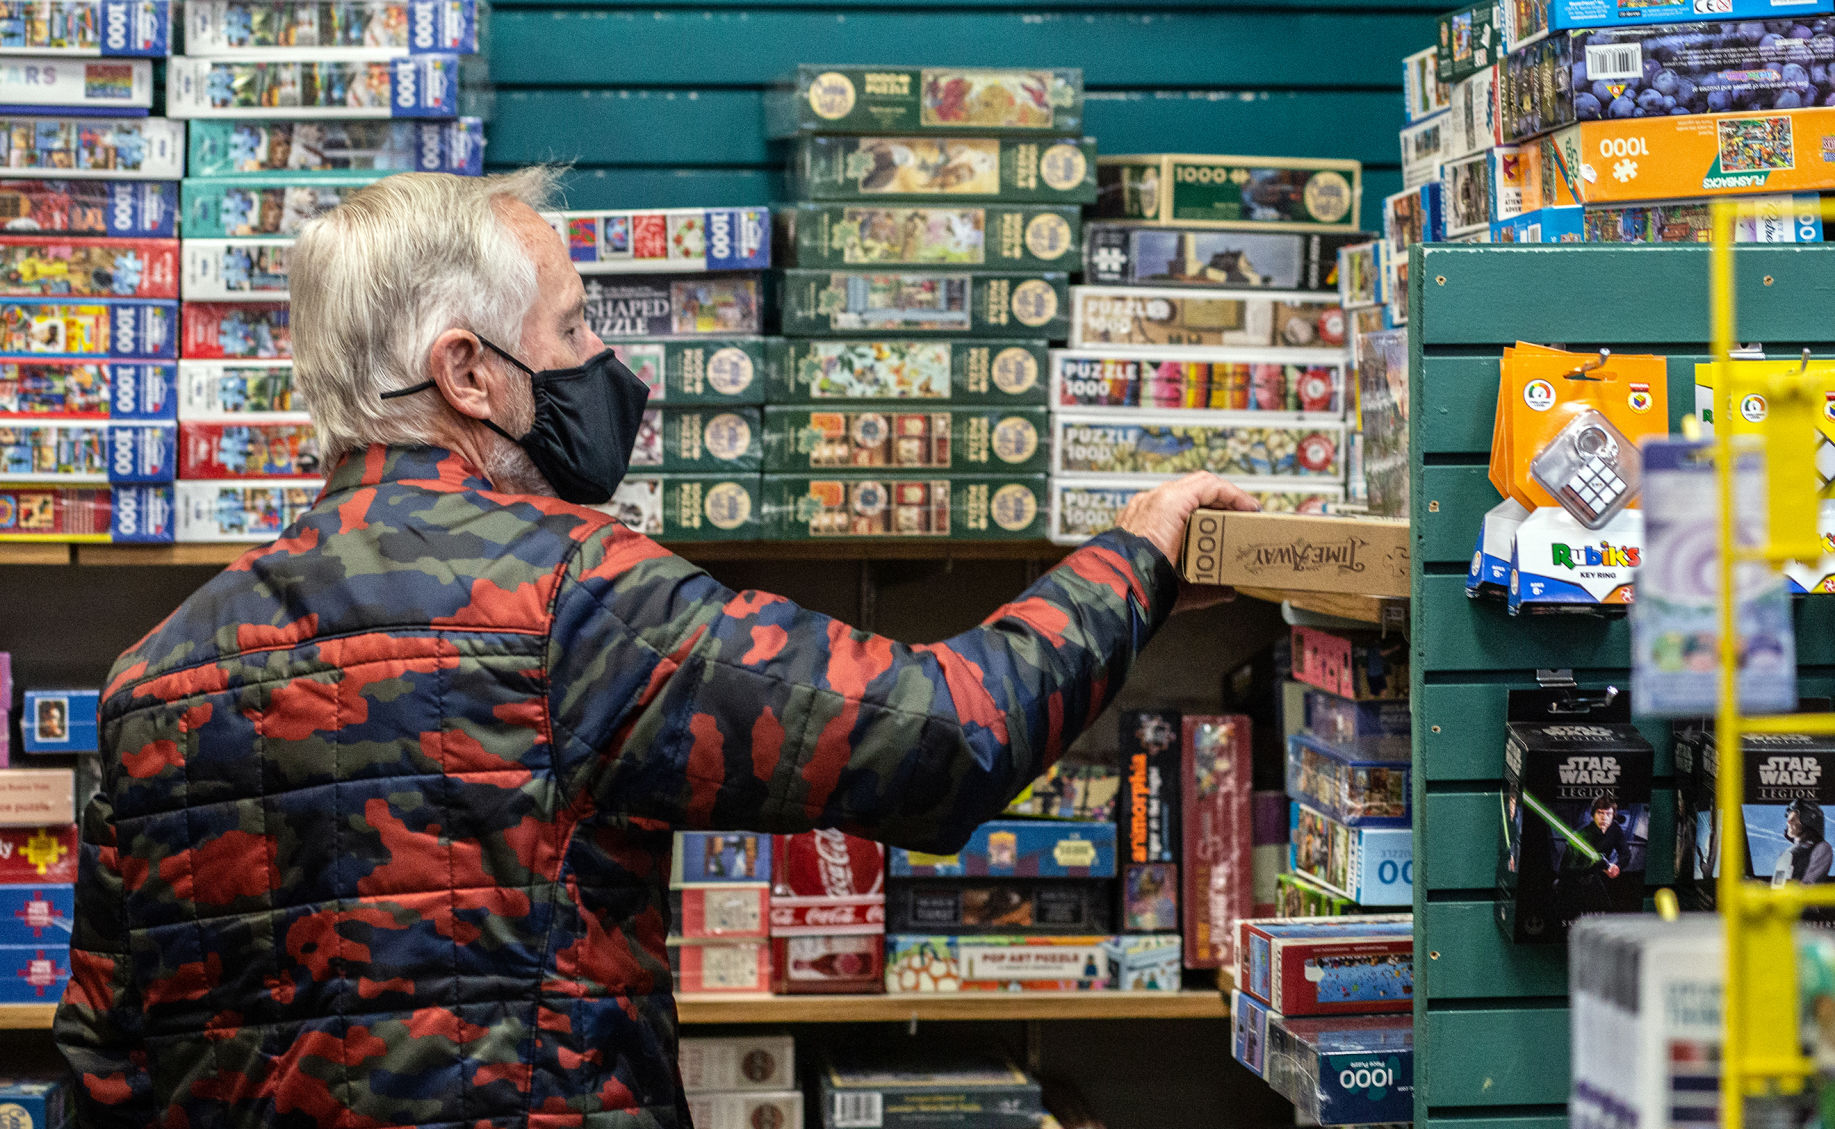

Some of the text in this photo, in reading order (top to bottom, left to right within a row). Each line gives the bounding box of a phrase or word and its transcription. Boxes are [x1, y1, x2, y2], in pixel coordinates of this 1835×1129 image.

[108, 2, 126, 49] 1000
[415, 1, 434, 48] 1000
[0, 65, 56, 85] ARS
[397, 62, 416, 107] 1000
[422, 125, 440, 169] 1000
[1600, 137, 1649, 158] 1000
[1176, 166, 1228, 184] 1000
[1702, 174, 1766, 190] FLASHBACKS
[113, 183, 132, 231] 1000
[711, 212, 729, 259] 1000
[586, 299, 670, 317] SHAPED
[116, 307, 135, 354] 1000
[588, 318, 649, 336] UZZLE
[1065, 362, 1138, 380] PUZZLE
[116, 367, 135, 413] 1000
[1065, 380, 1111, 398] 1000
[1066, 427, 1139, 445] PUZZLE
[114, 428, 133, 475] 1000
[118, 488, 137, 536] 1000
[1195, 517, 1218, 582] 1000
[1551, 540, 1641, 570] Rubik's
[1559, 756, 1621, 771] STAR
[1759, 756, 1821, 771] STAR
[1559, 770, 1621, 784] WARS
[1759, 770, 1821, 785] WARS
[1561, 787, 1615, 798] LEGION
[1761, 788, 1816, 799] LEGION
[982, 953, 1079, 963] POP ART PUZZLE
[1339, 1067, 1394, 1089] 1000
